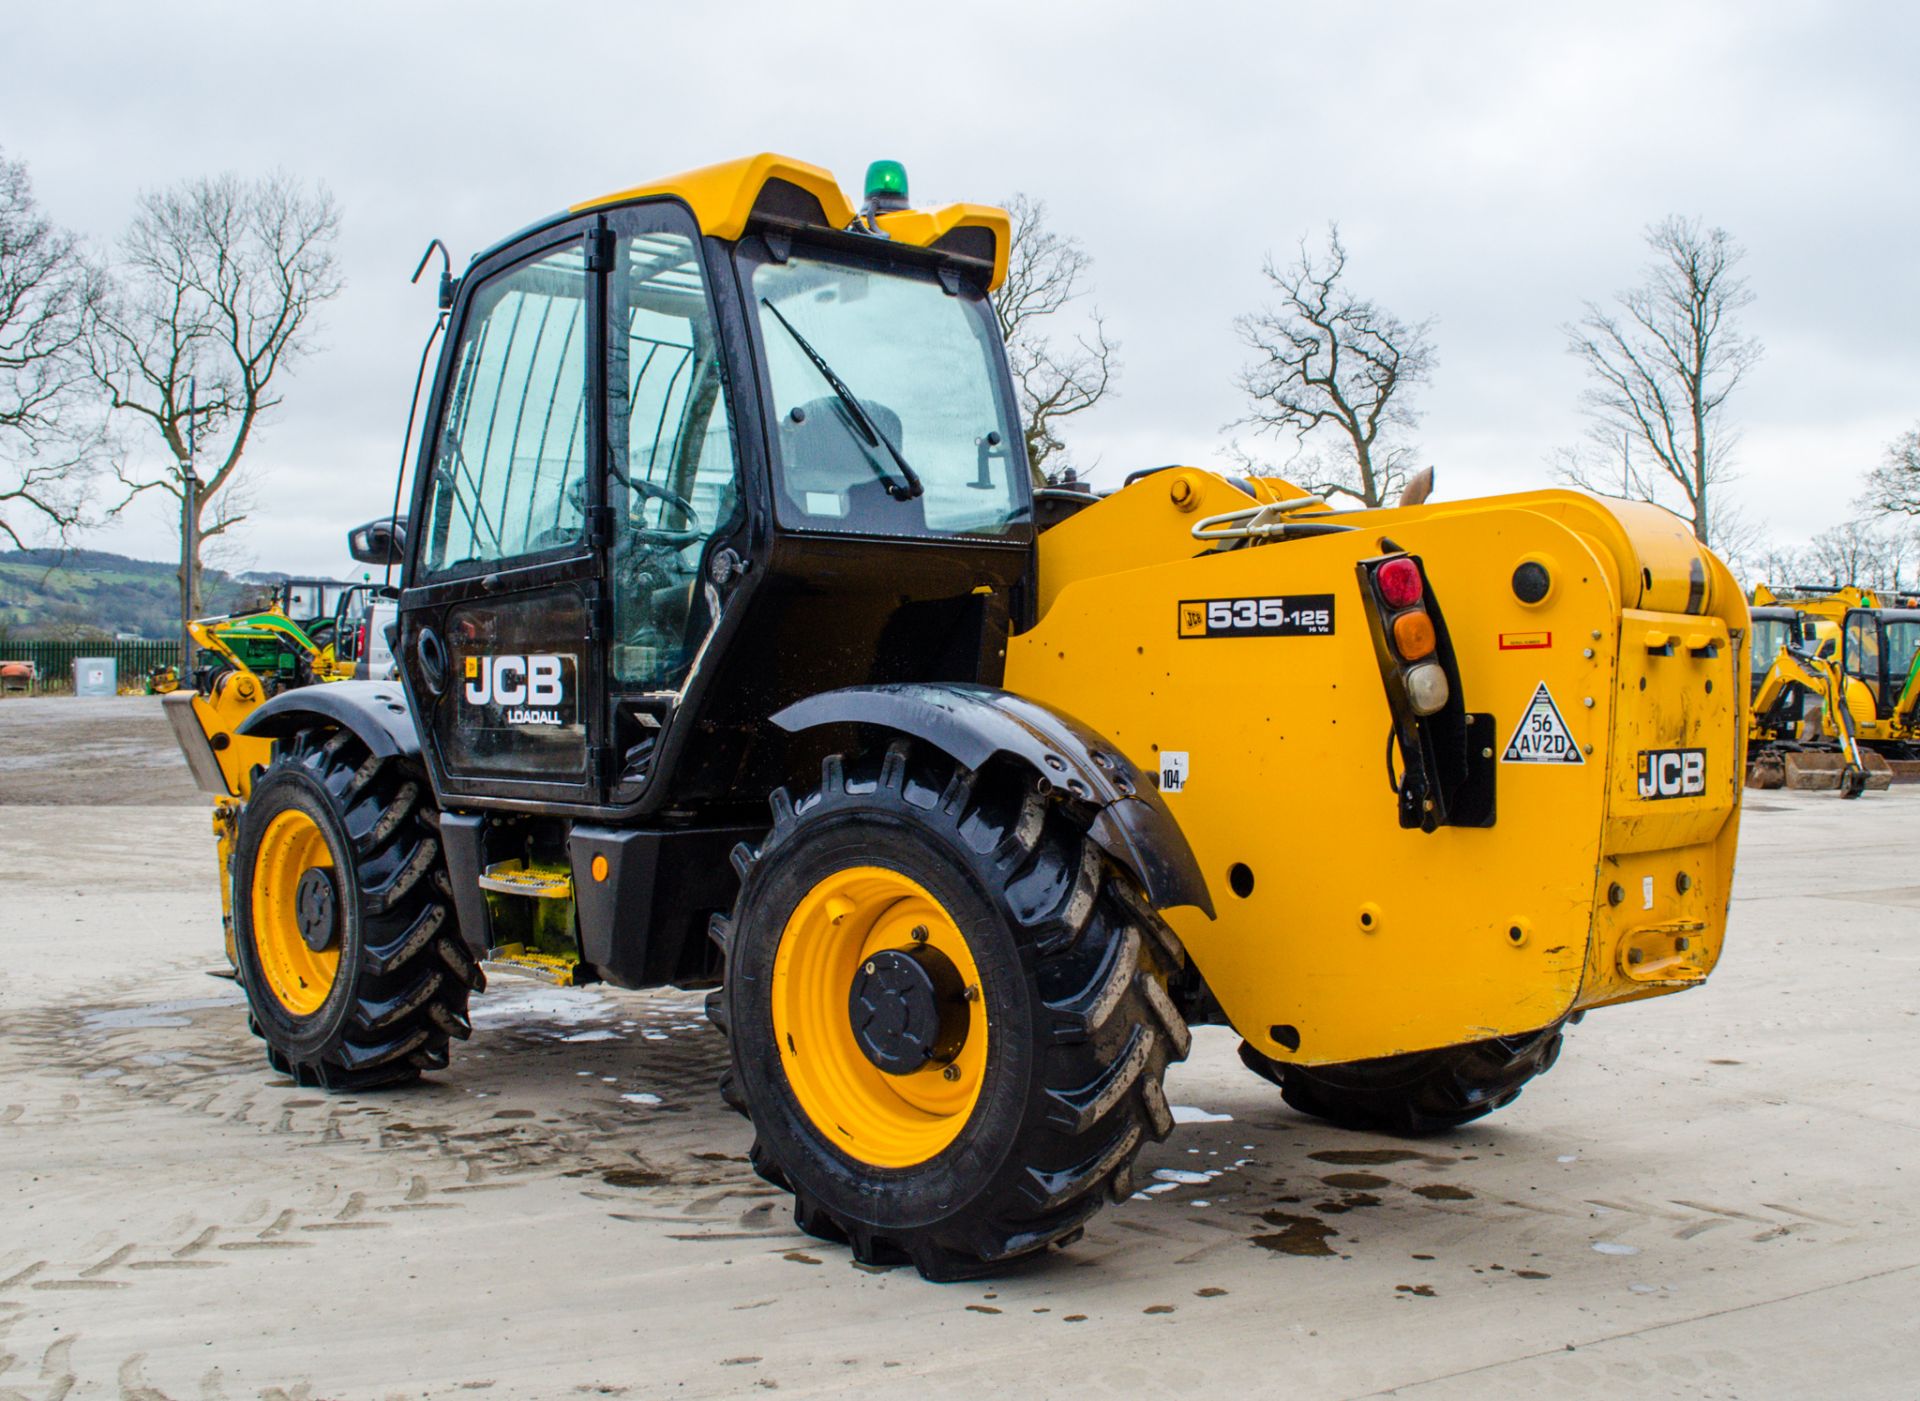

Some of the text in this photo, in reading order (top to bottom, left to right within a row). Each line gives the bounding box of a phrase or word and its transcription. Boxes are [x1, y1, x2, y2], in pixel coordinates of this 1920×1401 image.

[1186, 611, 1202, 627] JCB
[466, 656, 563, 705] JCB
[508, 709, 562, 724] LOADALL
[1531, 713, 1552, 733] 56
[1520, 734, 1565, 754] AV2D
[1163, 769, 1180, 789] 104
[1638, 752, 1705, 797] JCB
